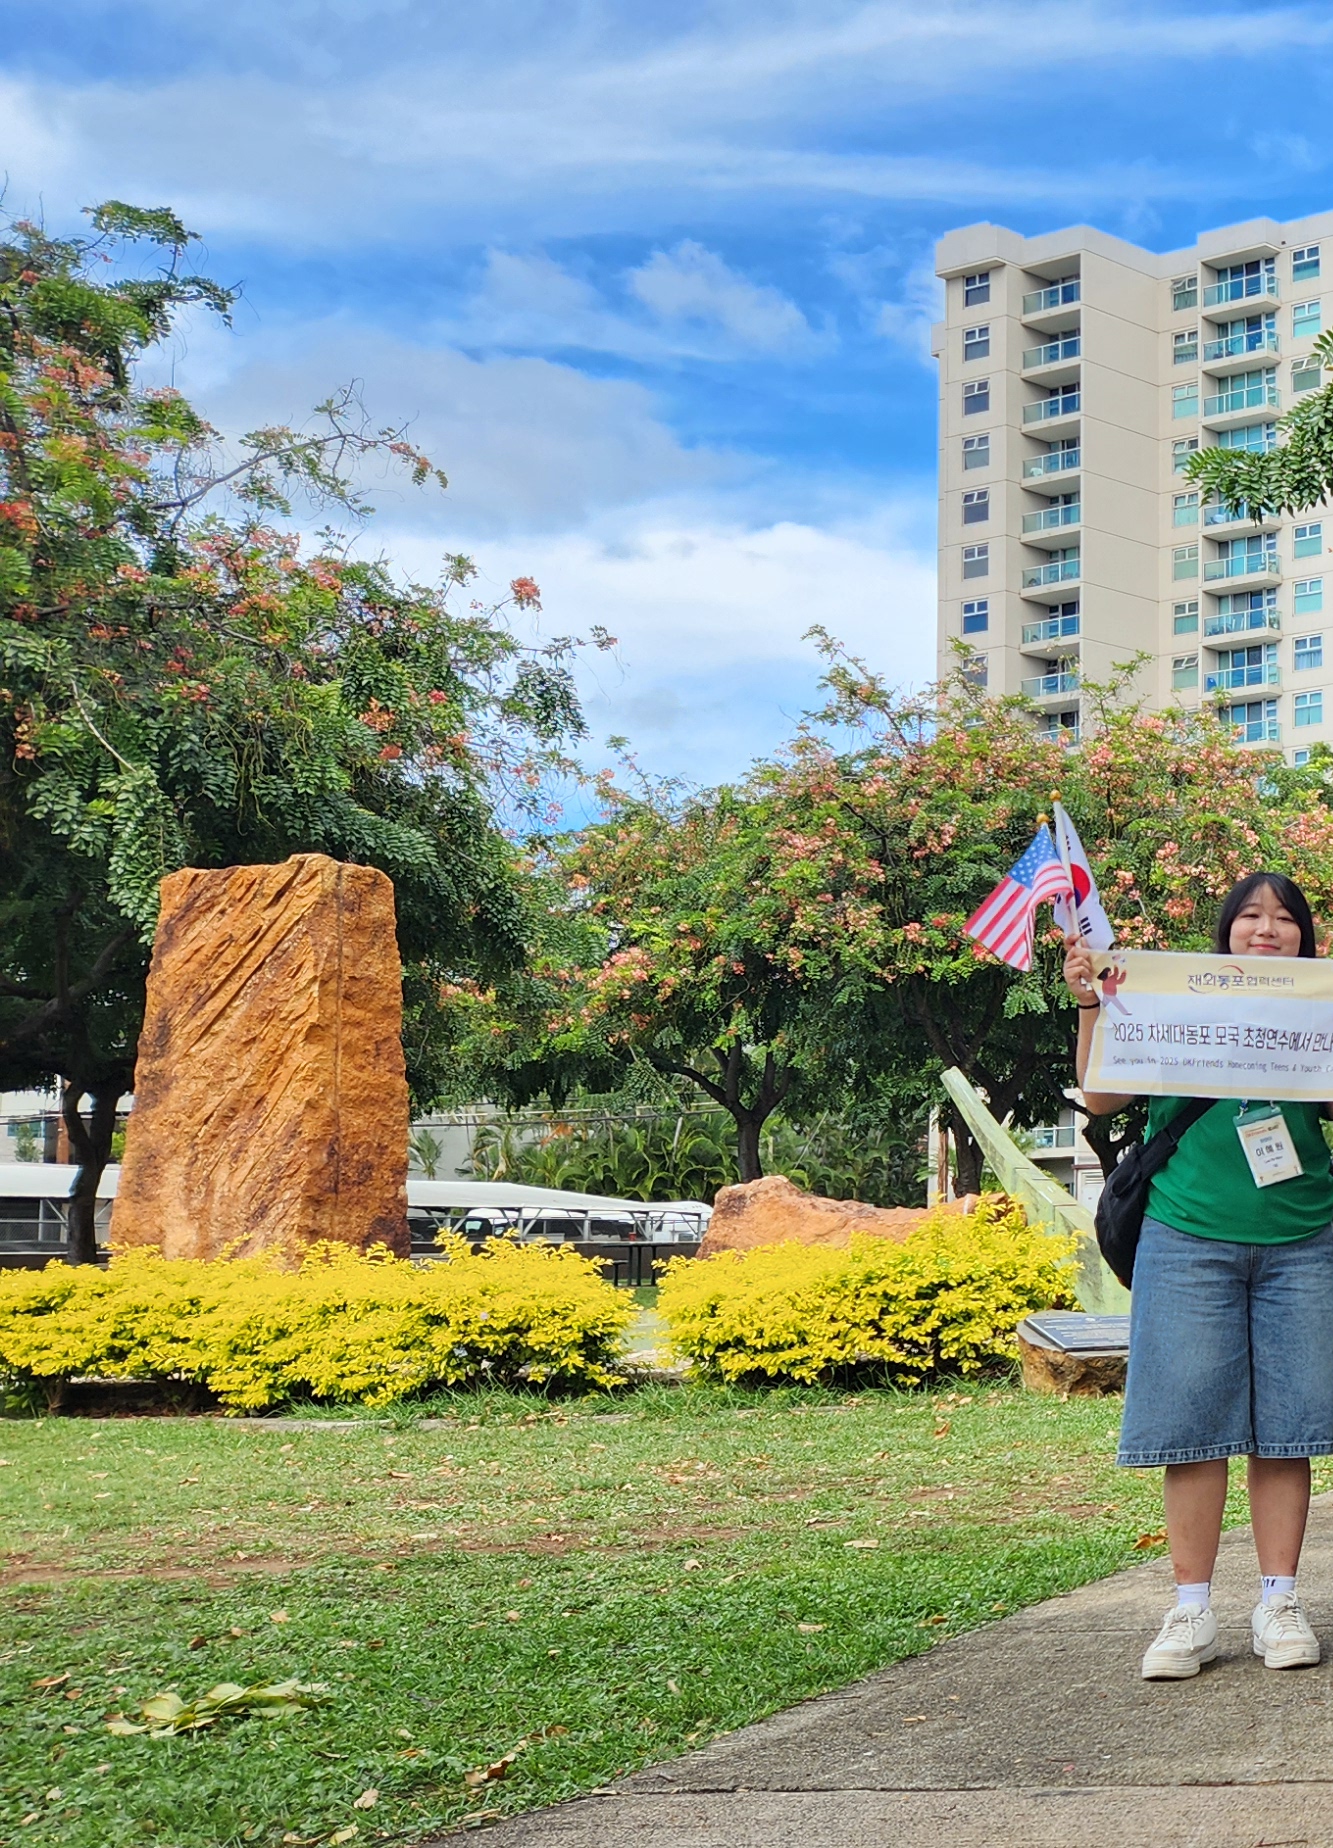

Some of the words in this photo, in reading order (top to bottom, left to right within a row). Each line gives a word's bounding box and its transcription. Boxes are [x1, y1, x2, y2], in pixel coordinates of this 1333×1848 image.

[1113, 1022, 1144, 1042] 2025
[1148, 1023, 1211, 1046] 차세대동포
[1215, 1025, 1239, 1047] 모국
[1243, 1026, 1313, 1052] 초청연수에서
[1160, 1056, 1179, 1066] 2025
